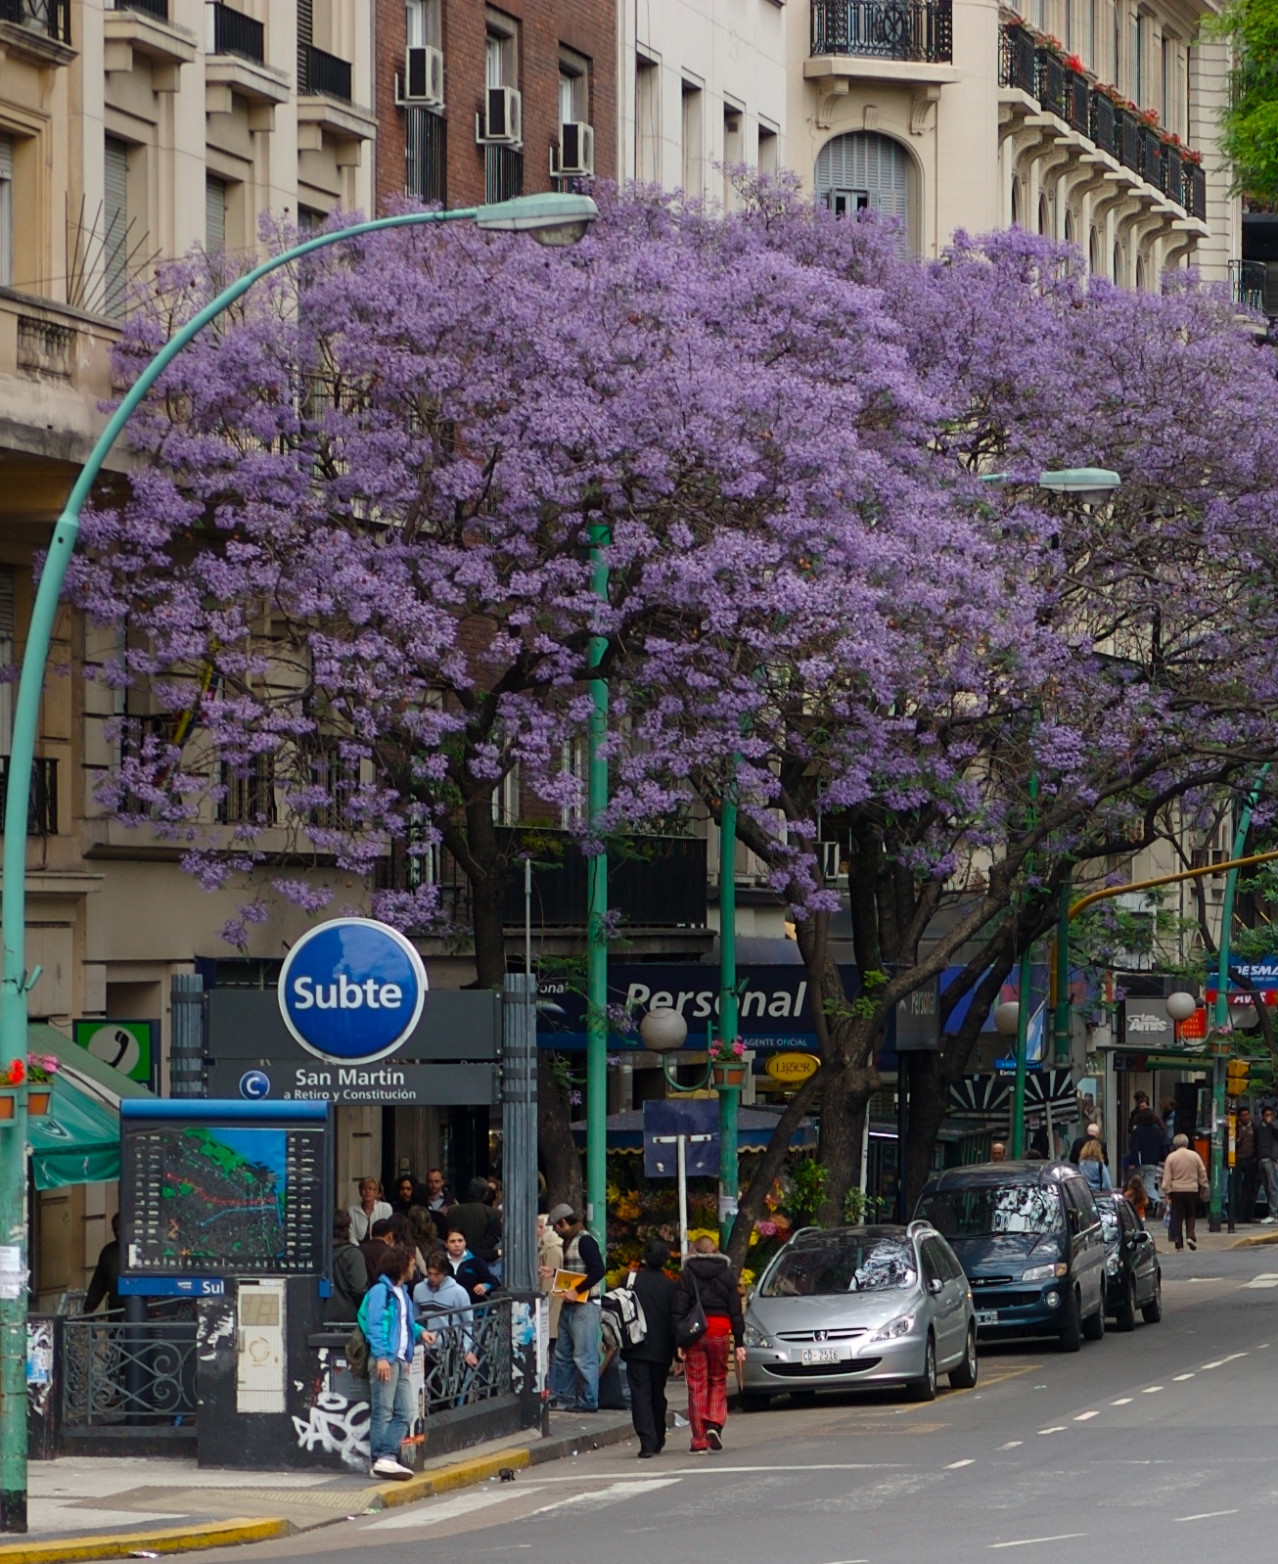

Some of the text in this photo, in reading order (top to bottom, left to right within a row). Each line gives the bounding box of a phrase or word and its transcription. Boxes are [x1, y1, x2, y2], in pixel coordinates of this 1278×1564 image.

[293, 974, 403, 1010] Subte
[743, 1038, 808, 1047] AGENTE OFICIAL
[295, 1067, 405, 1086] San Martín
[246, 1076, 260, 1095] C
[283, 1089, 416, 1102] a Retiro y Constitución
[202, 1280, 225, 1294] Sul
